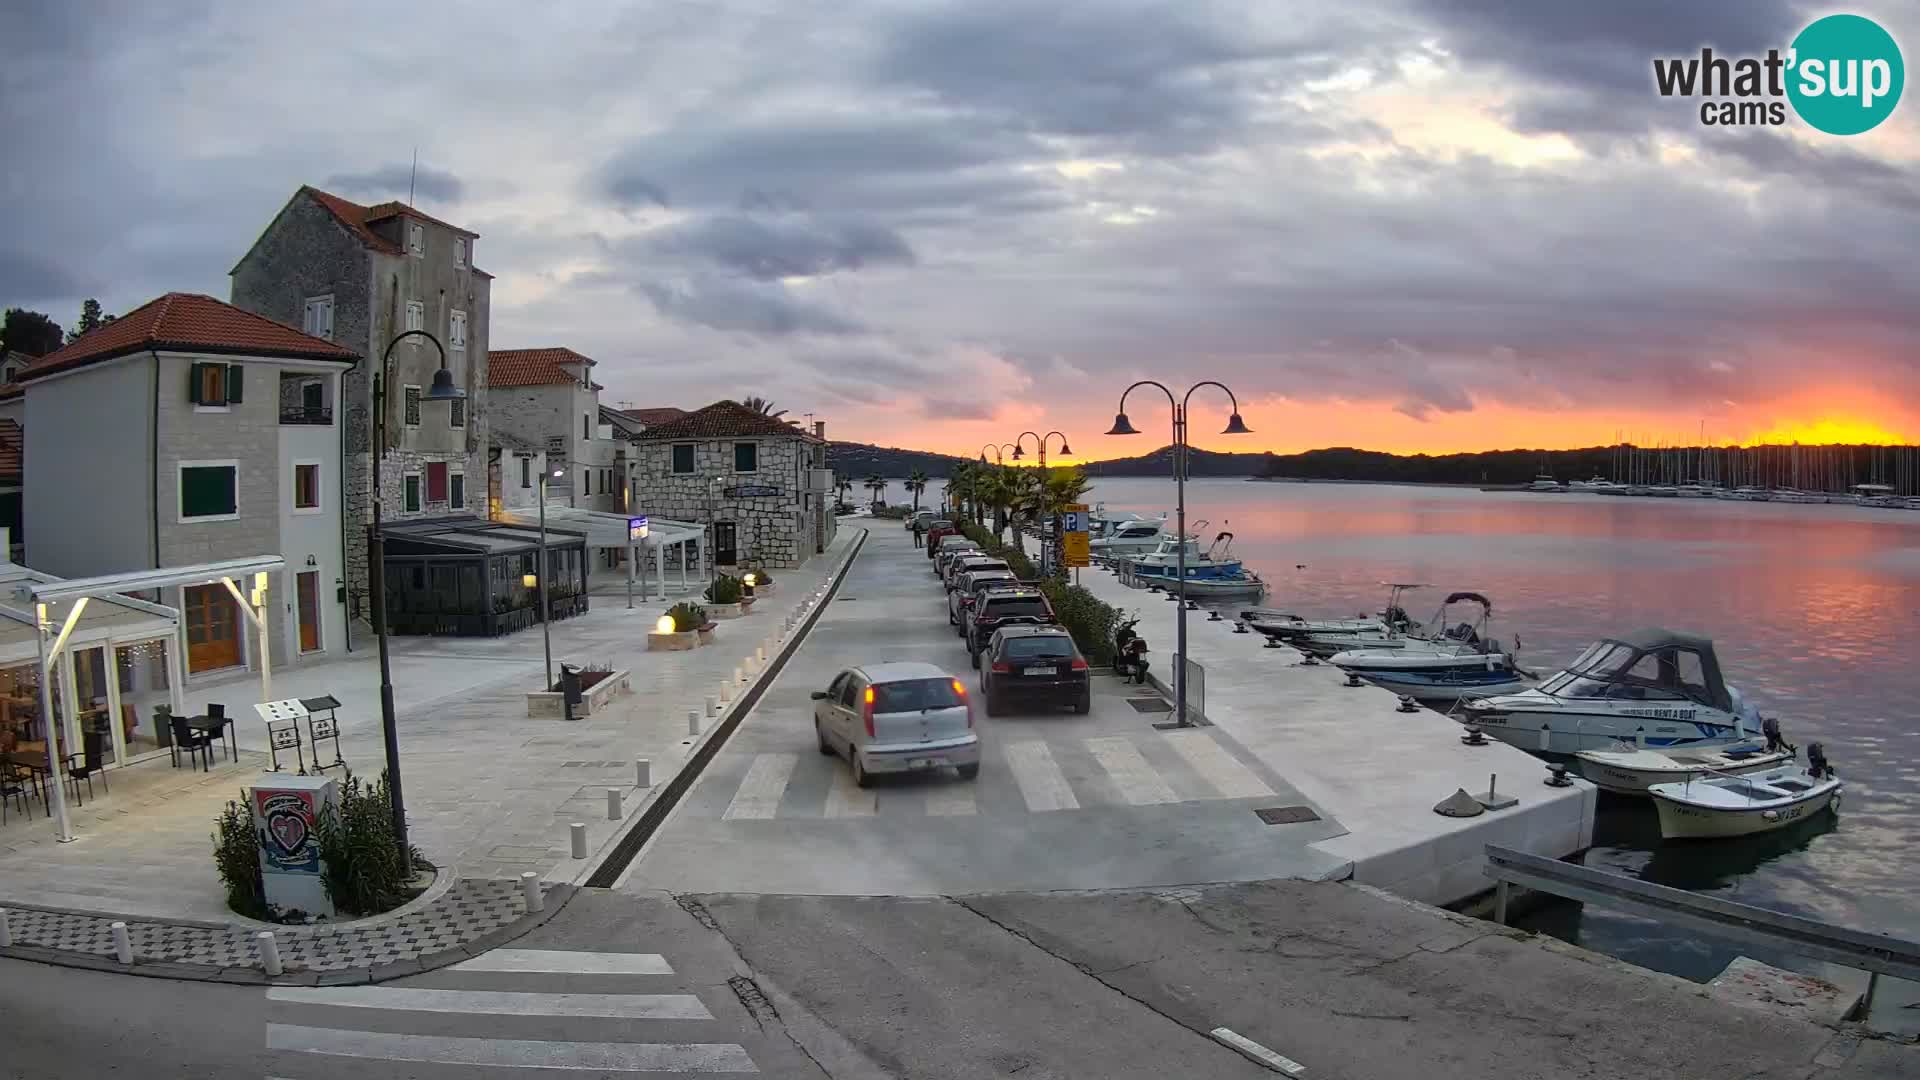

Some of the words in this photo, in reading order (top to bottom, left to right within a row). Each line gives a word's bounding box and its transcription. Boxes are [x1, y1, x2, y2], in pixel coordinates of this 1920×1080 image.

[1066, 513, 1077, 530] P
[1654, 709, 1672, 719] RENT
[1672, 709, 1678, 719] A
[1679, 709, 1697, 721] BOAT
